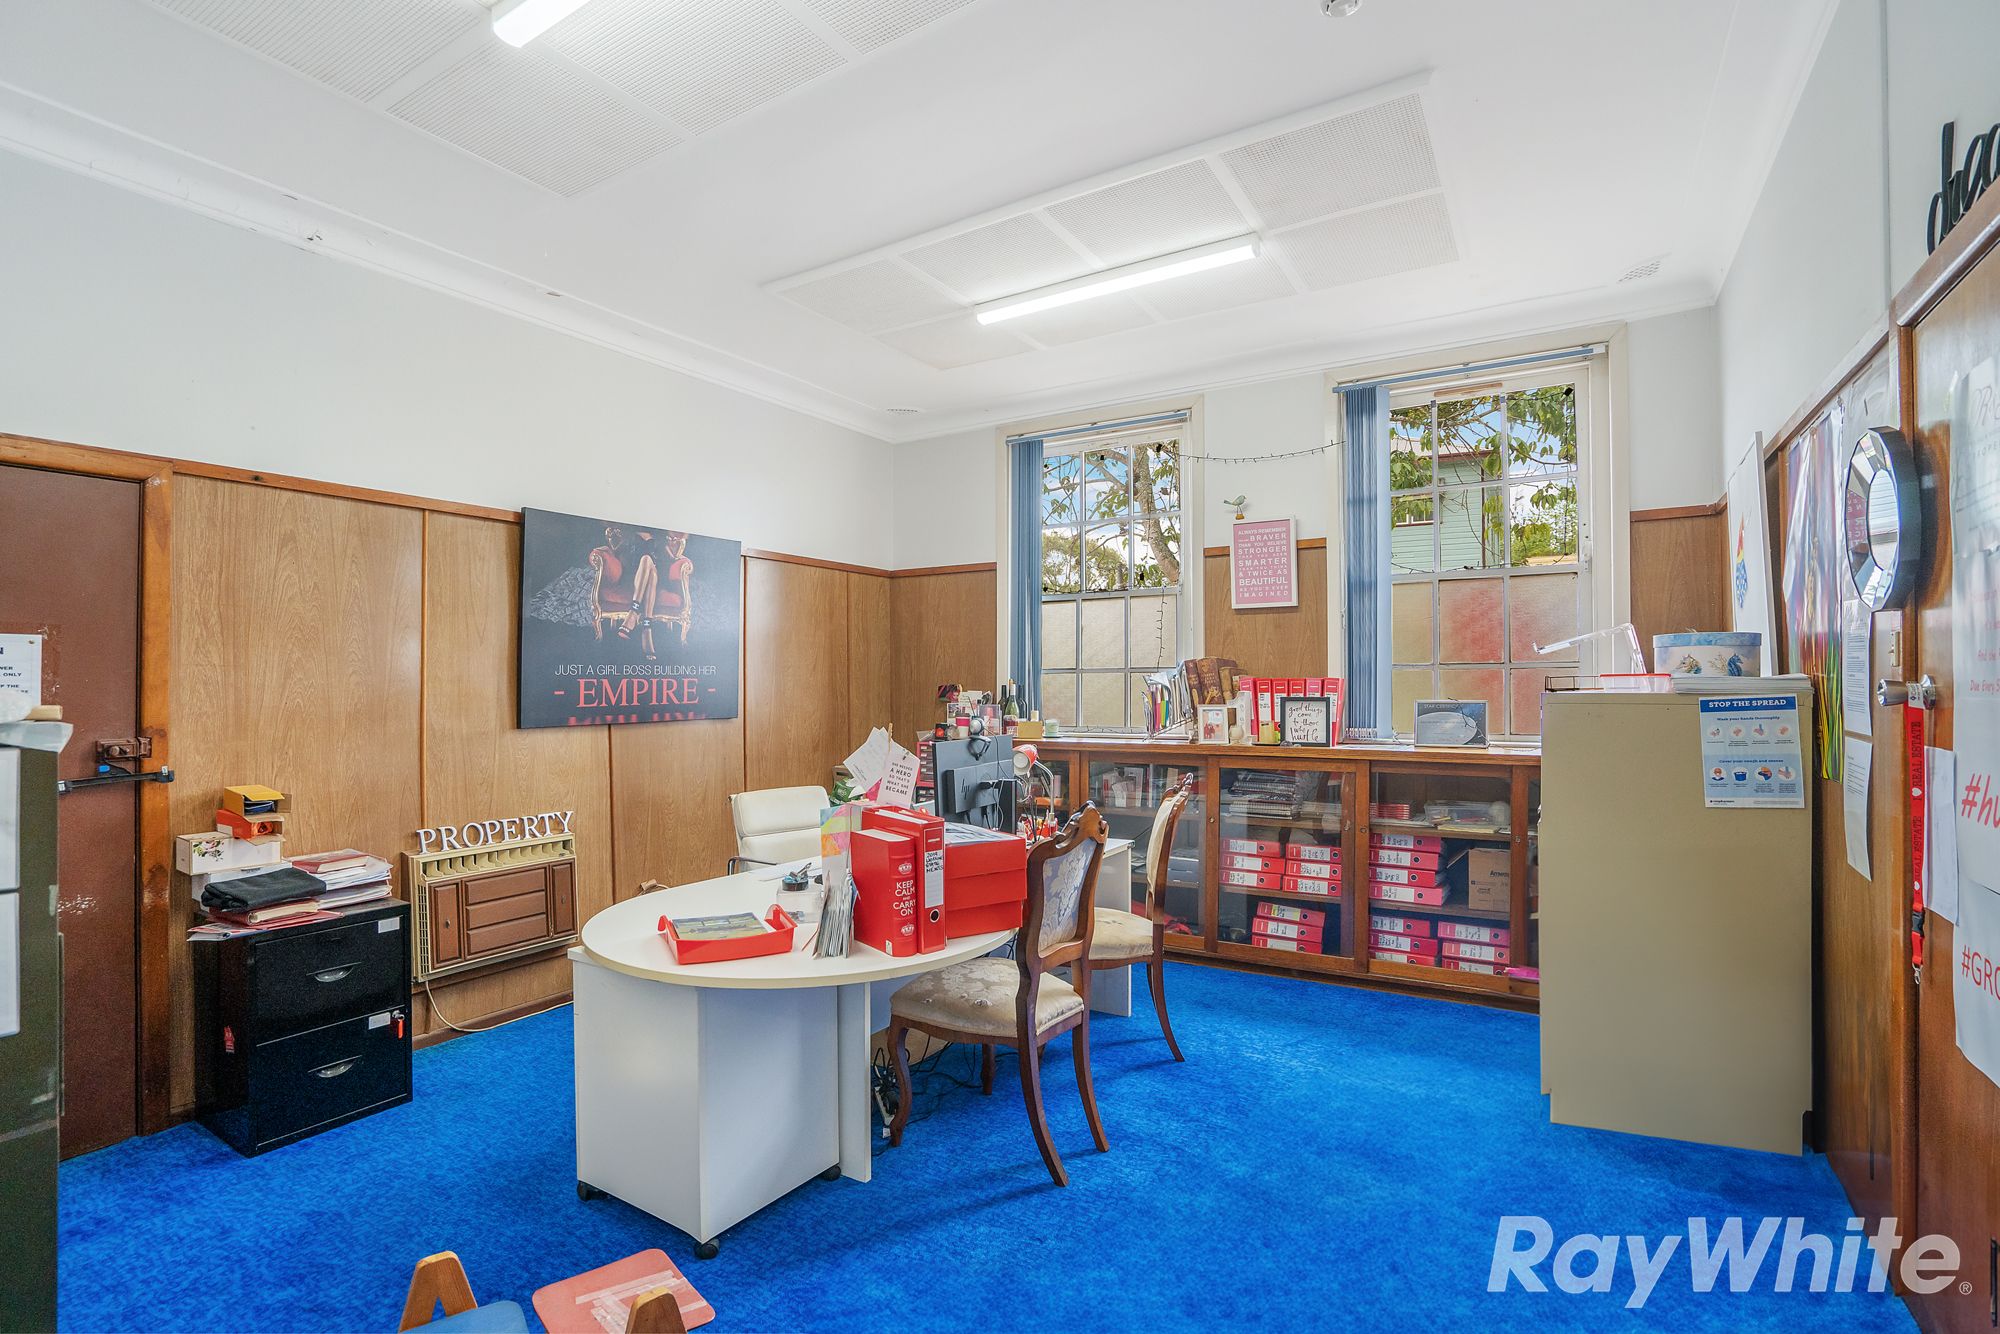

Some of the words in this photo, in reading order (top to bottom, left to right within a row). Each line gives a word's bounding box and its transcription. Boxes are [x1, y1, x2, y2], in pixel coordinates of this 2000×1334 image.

[1250, 533, 1287, 541] BRAVER
[1238, 546, 1287, 555] STRONGER
[1238, 558, 1288, 566] SMARTER
[1239, 576, 1288, 586] BEAUTIFUL
[554, 664, 584, 676] JUST
[586, 664, 594, 676] A
[597, 664, 620, 676] GIRL
[623, 664, 652, 676] BOSS
[654, 665, 696, 676] BUILDING
[698, 665, 716, 676] HER
[576, 678, 700, 708] EMPIRE
[1288, 702, 1302, 718] good
[1305, 703, 1323, 717] things
[1290, 728, 1319, 742] hustle
[1911, 722, 1922, 760] ESTATE
[896, 769, 912, 777] HERO
[1912, 760, 1923, 787] REAL
[886, 786, 908, 795] BECAME
[961, 777, 970, 798] hp
[416, 810, 574, 854] PROPERTY
[1913, 815, 1922, 852] ESTATE
[896, 880, 913, 889] KEEP
[895, 887, 915, 897] CALM
[893, 900, 916, 910] CARRY
[900, 908, 913, 916] ON
